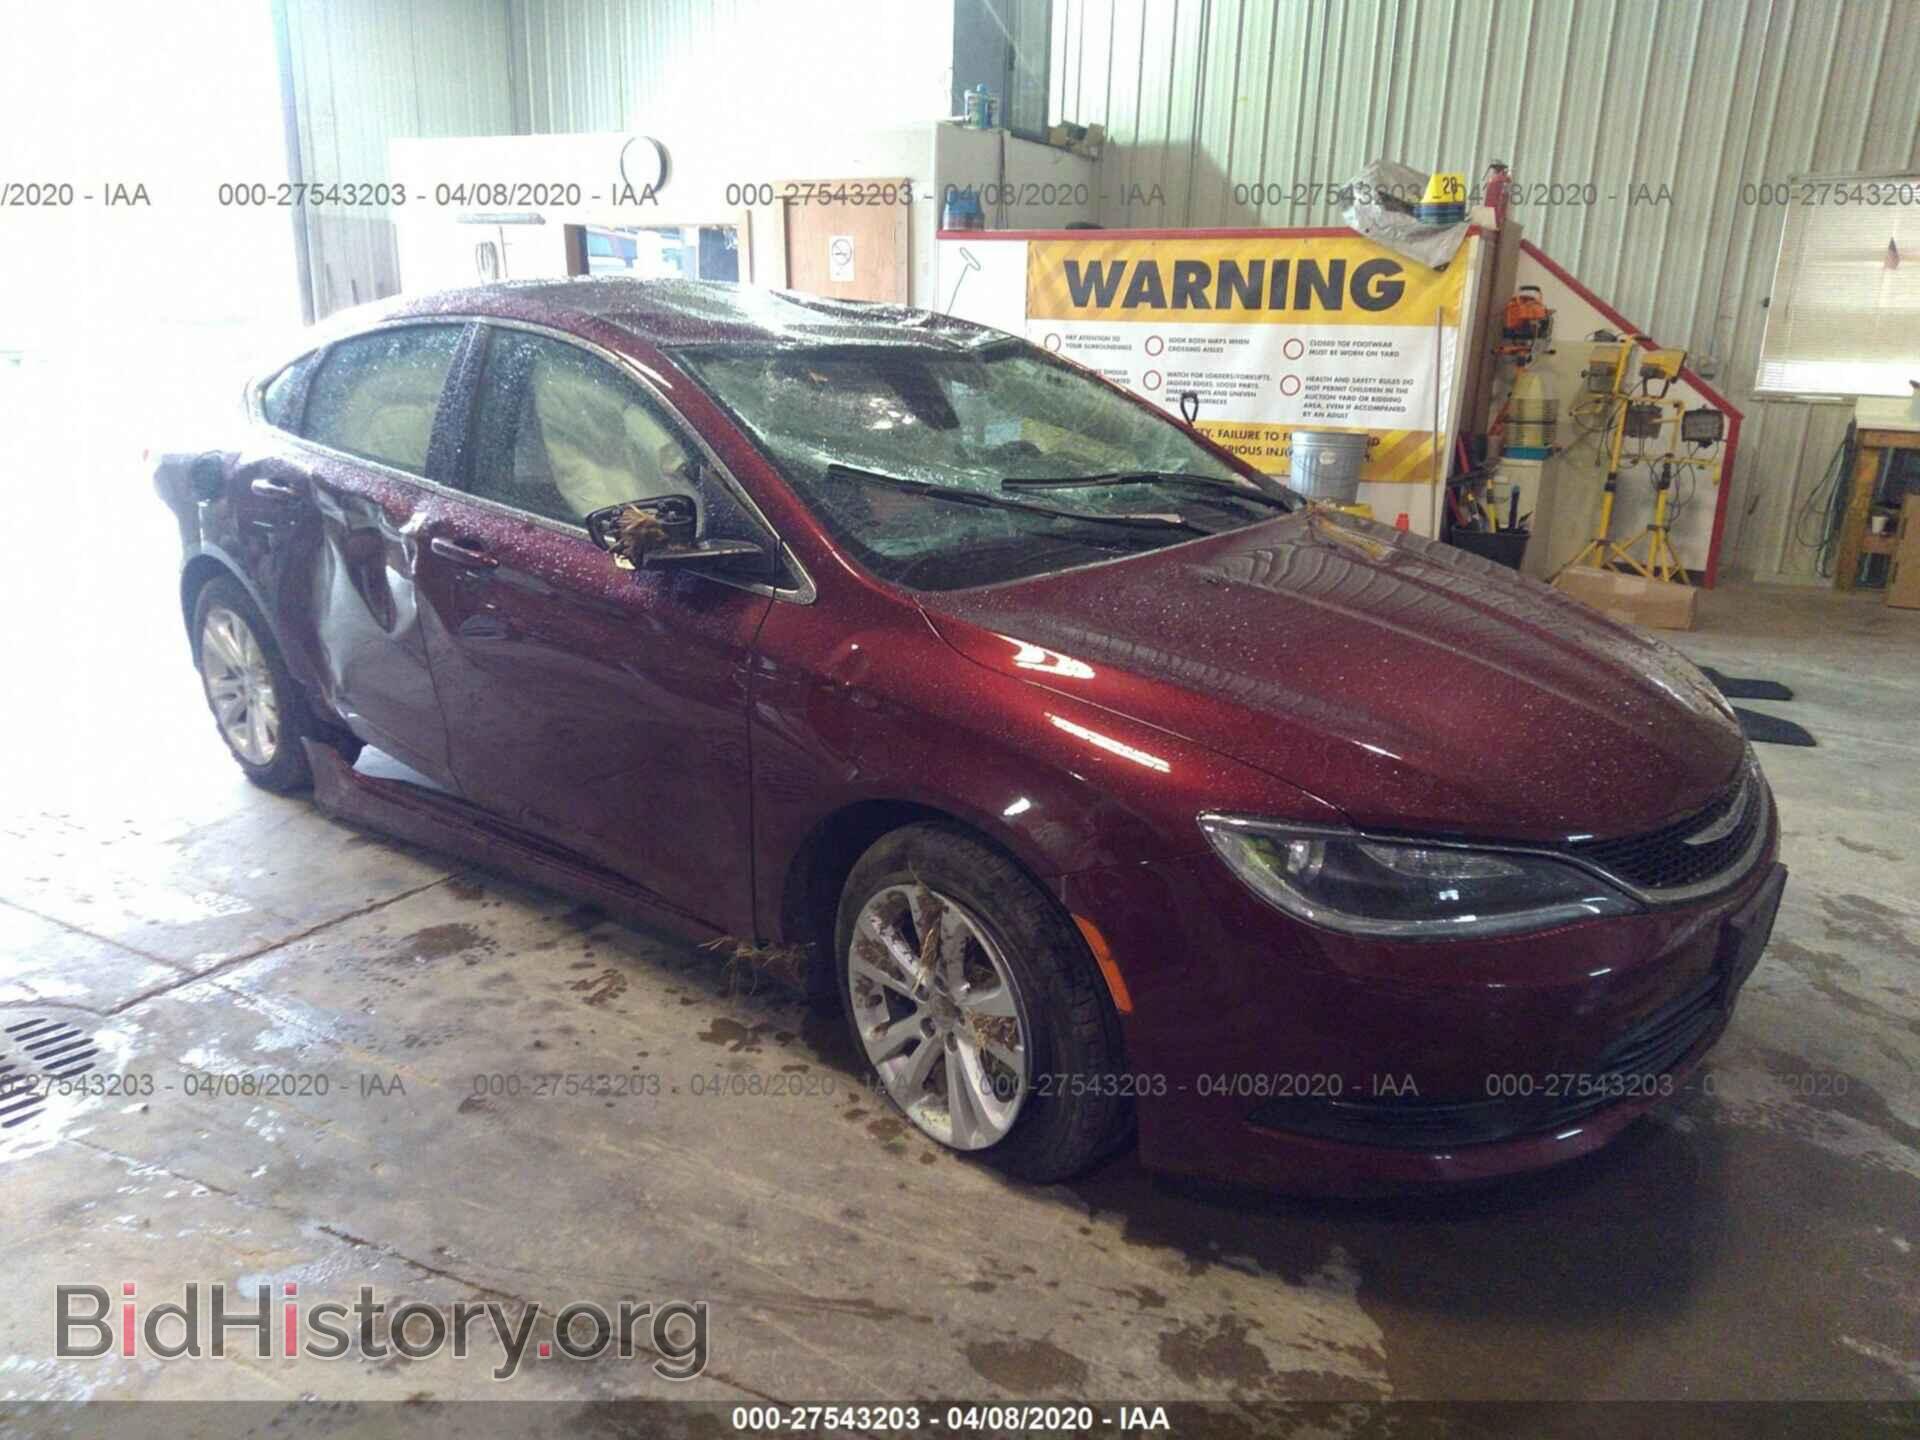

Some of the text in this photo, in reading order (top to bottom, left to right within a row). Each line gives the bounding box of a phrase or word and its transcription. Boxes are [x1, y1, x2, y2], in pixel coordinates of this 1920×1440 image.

[1063, 258, 1405, 312] WARNING
[1217, 428, 1261, 441] FAILURE
[1264, 431, 1280, 442] TO
